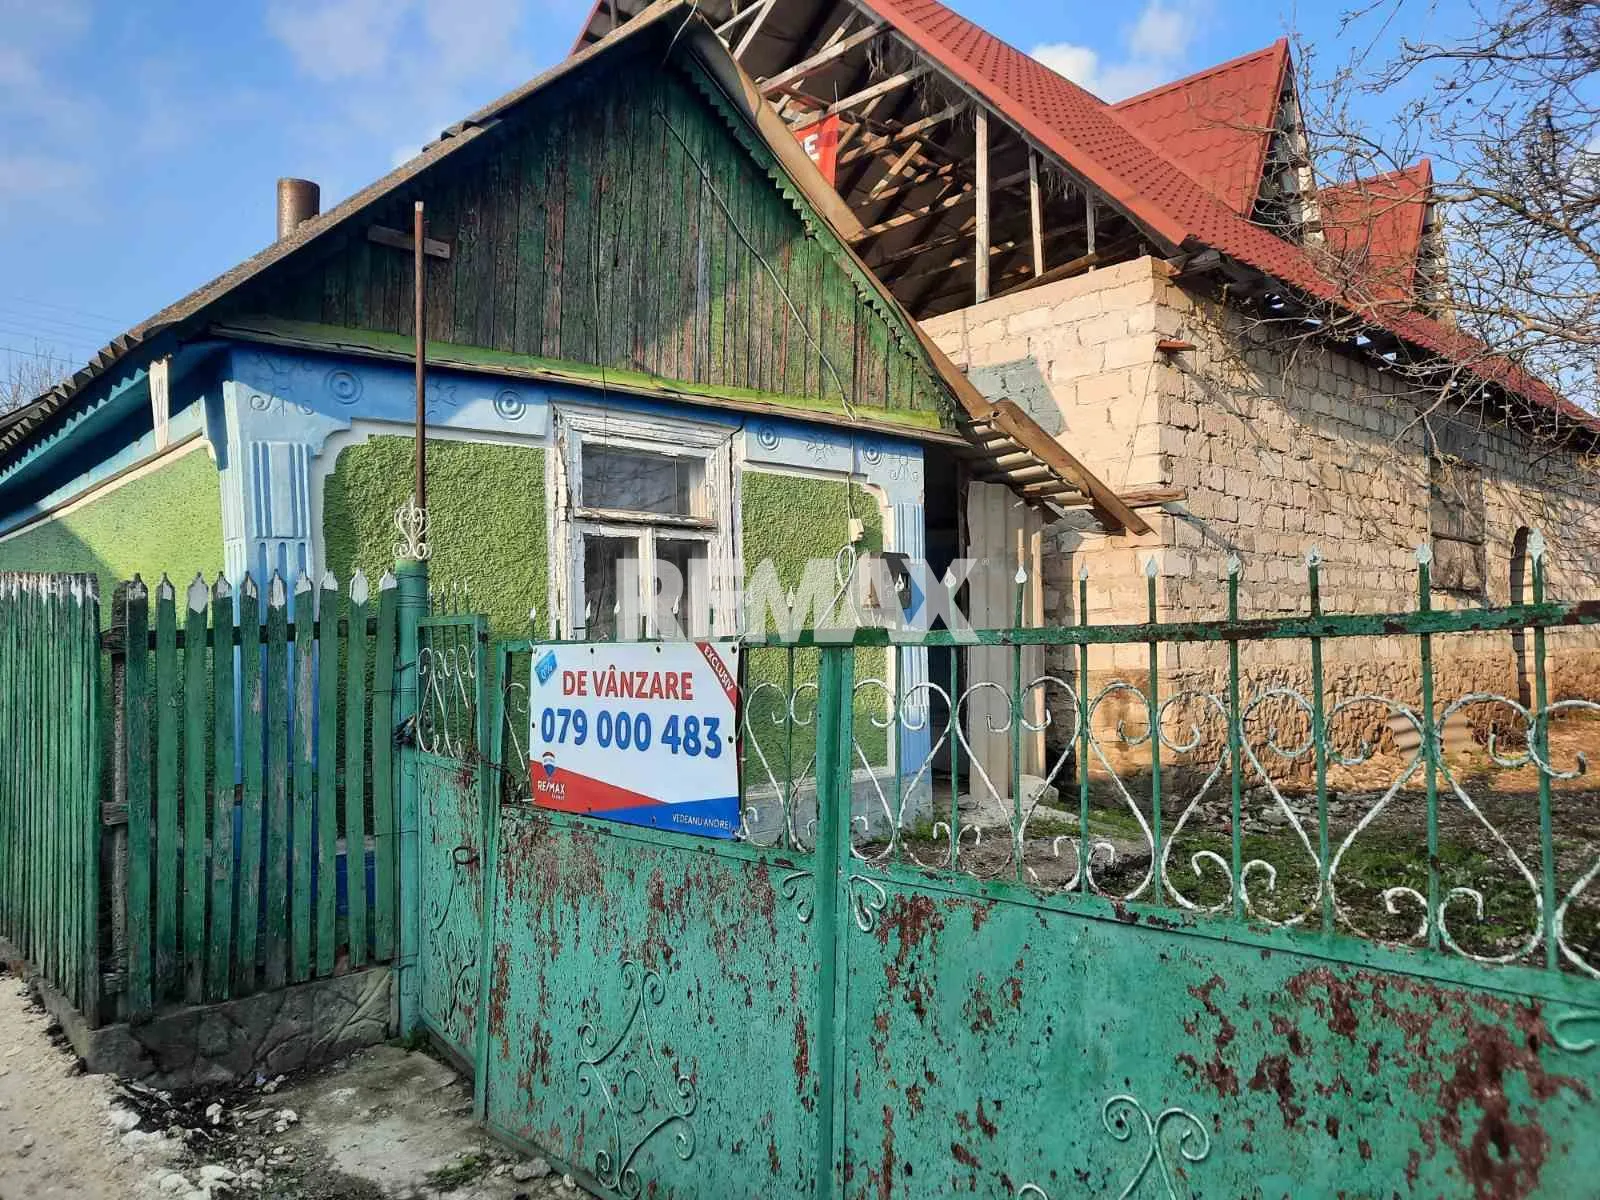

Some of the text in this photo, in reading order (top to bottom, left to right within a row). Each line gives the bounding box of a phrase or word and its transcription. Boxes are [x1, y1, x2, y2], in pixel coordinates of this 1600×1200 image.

[563, 664, 694, 701] DE VÂNZARE
[541, 707, 722, 759] 079 000 483
